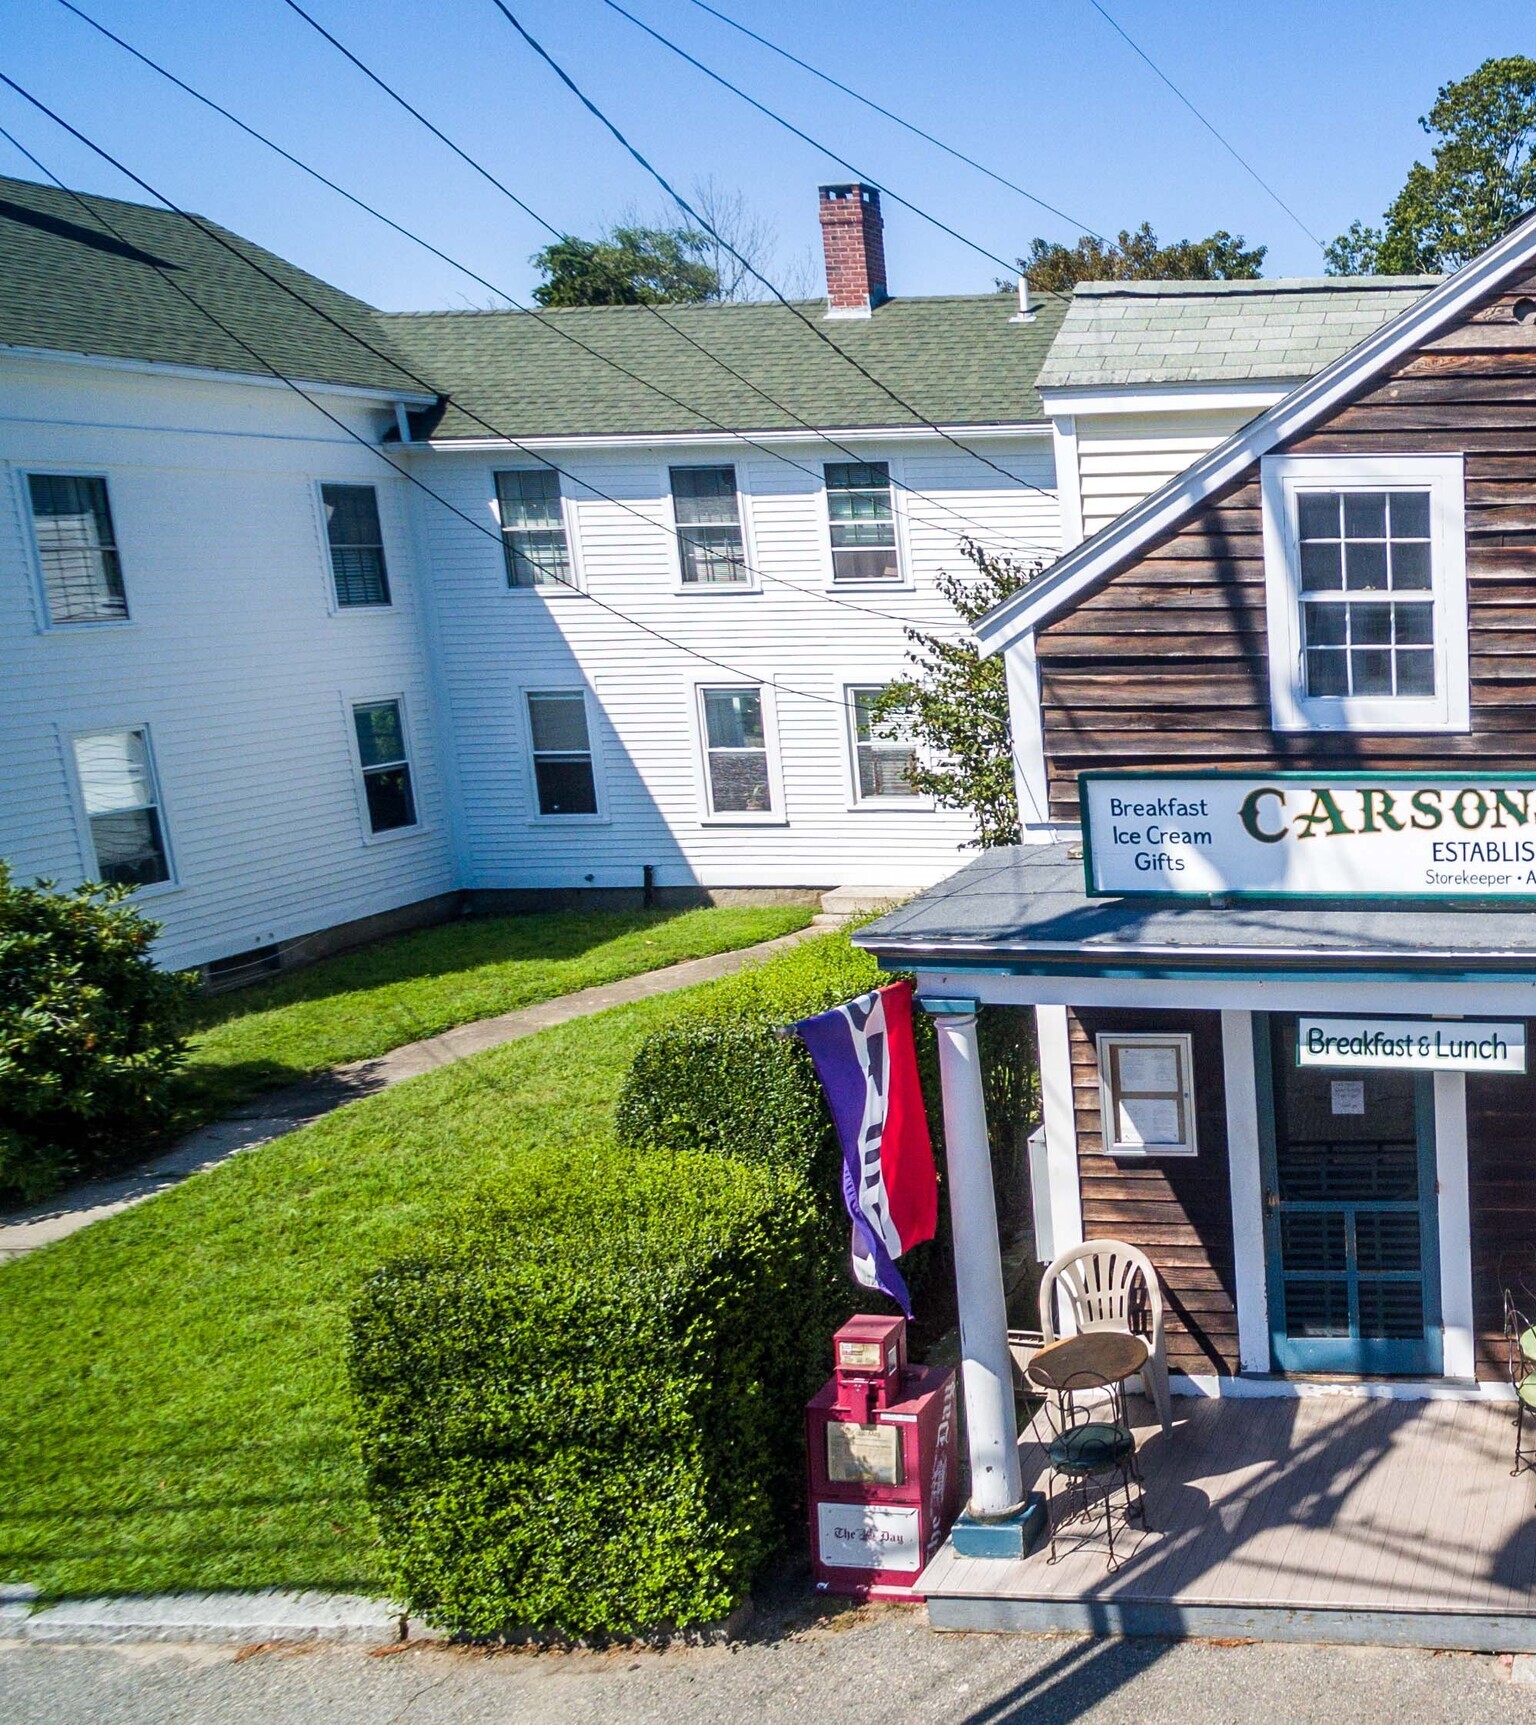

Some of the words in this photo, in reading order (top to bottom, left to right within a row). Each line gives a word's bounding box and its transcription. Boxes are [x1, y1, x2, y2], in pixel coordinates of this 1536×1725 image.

[1110, 798, 1208, 817] Breakfast
[1113, 825, 1141, 845] Ice
[1146, 826, 1212, 845] Cream
[1134, 851, 1185, 872] Gifts
[1425, 869, 1512, 887] Storekeeper
[1307, 1027, 1413, 1057] Breakfast
[1418, 1036, 1430, 1057] &
[1435, 1031, 1507, 1059] Lunch
[834, 1527, 856, 1540] The
[880, 1531, 904, 1546] Day
